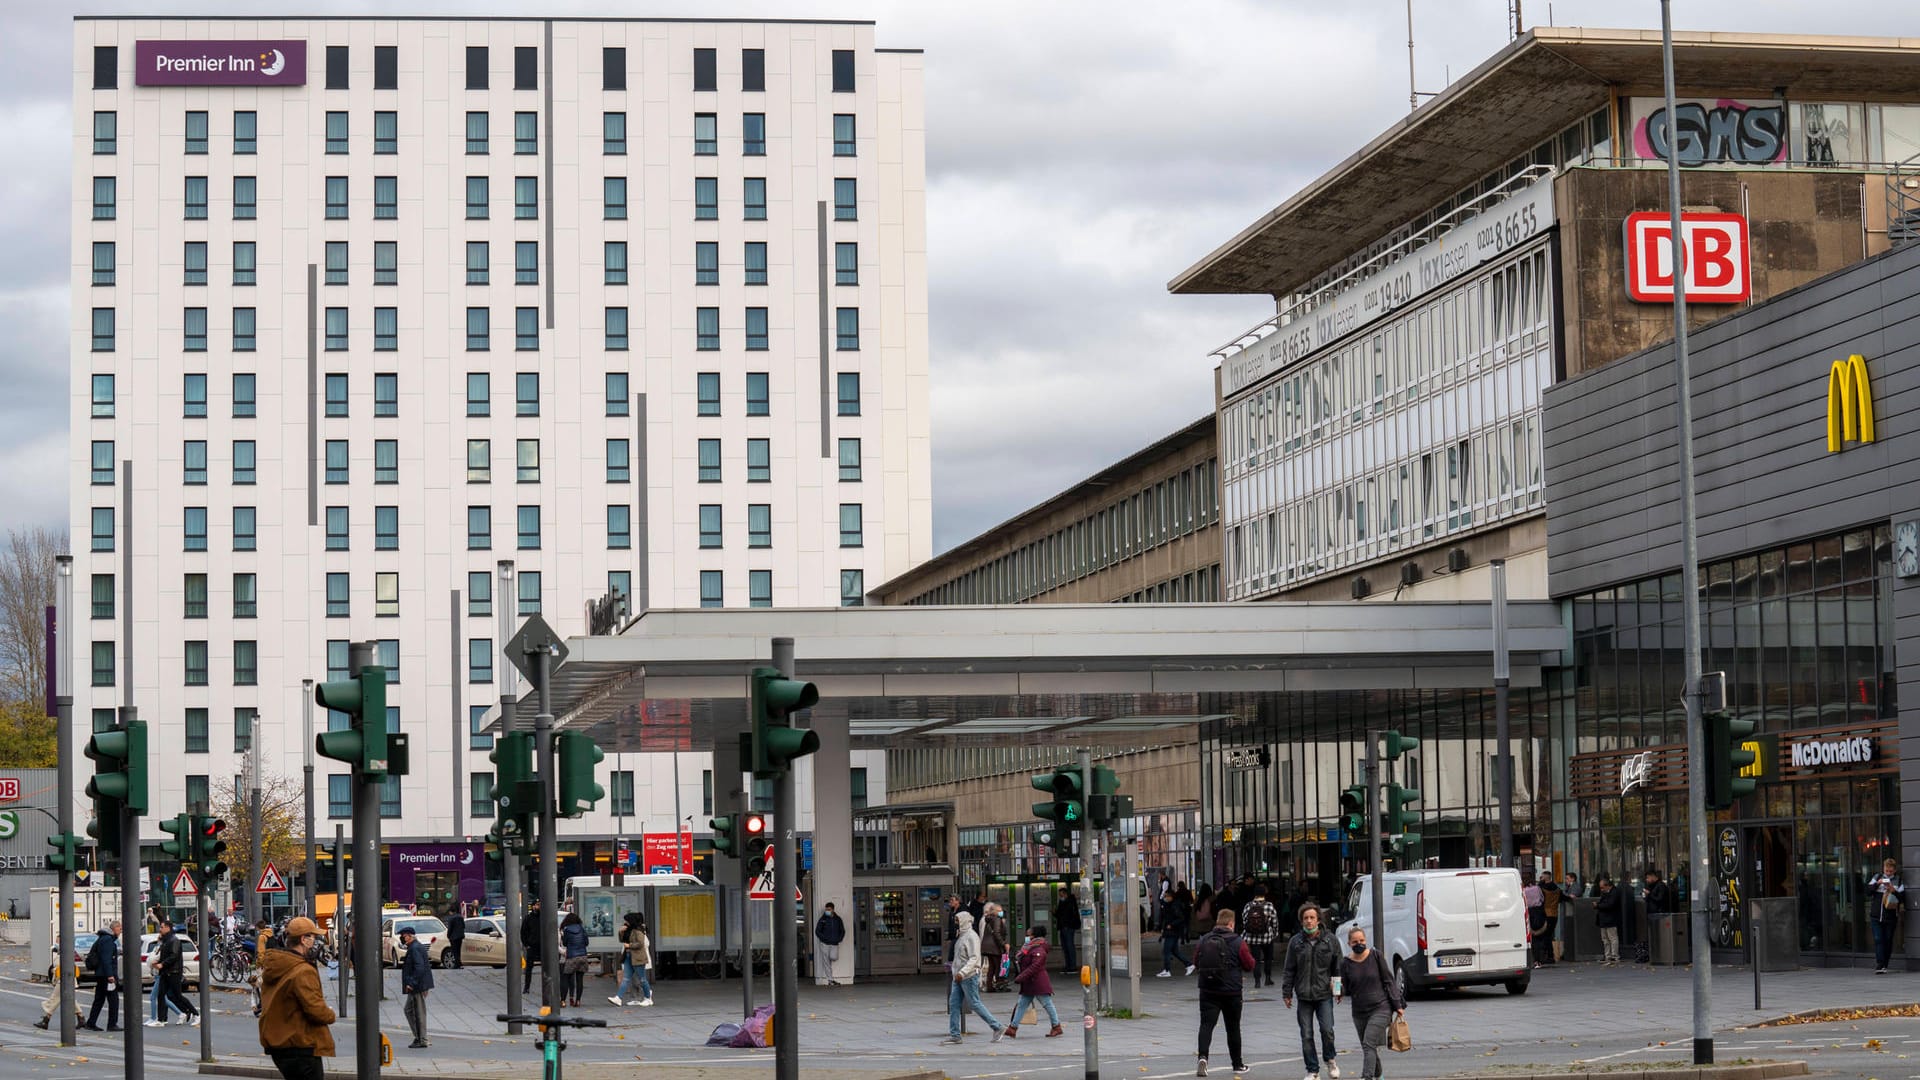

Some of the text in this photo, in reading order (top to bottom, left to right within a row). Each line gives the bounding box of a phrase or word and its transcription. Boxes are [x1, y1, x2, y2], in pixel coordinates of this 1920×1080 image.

[156, 55, 255, 72] Premier Inn
[1644, 227, 1735, 288] DB
[1364, 289, 1378, 312] 0201
[1477, 225, 1494, 251] 0201
[1791, 736, 1873, 768] McDonald's
[786, 829, 792, 840] 2
[369, 840, 375, 851] 3
[400, 852, 456, 863] Premier Inn
